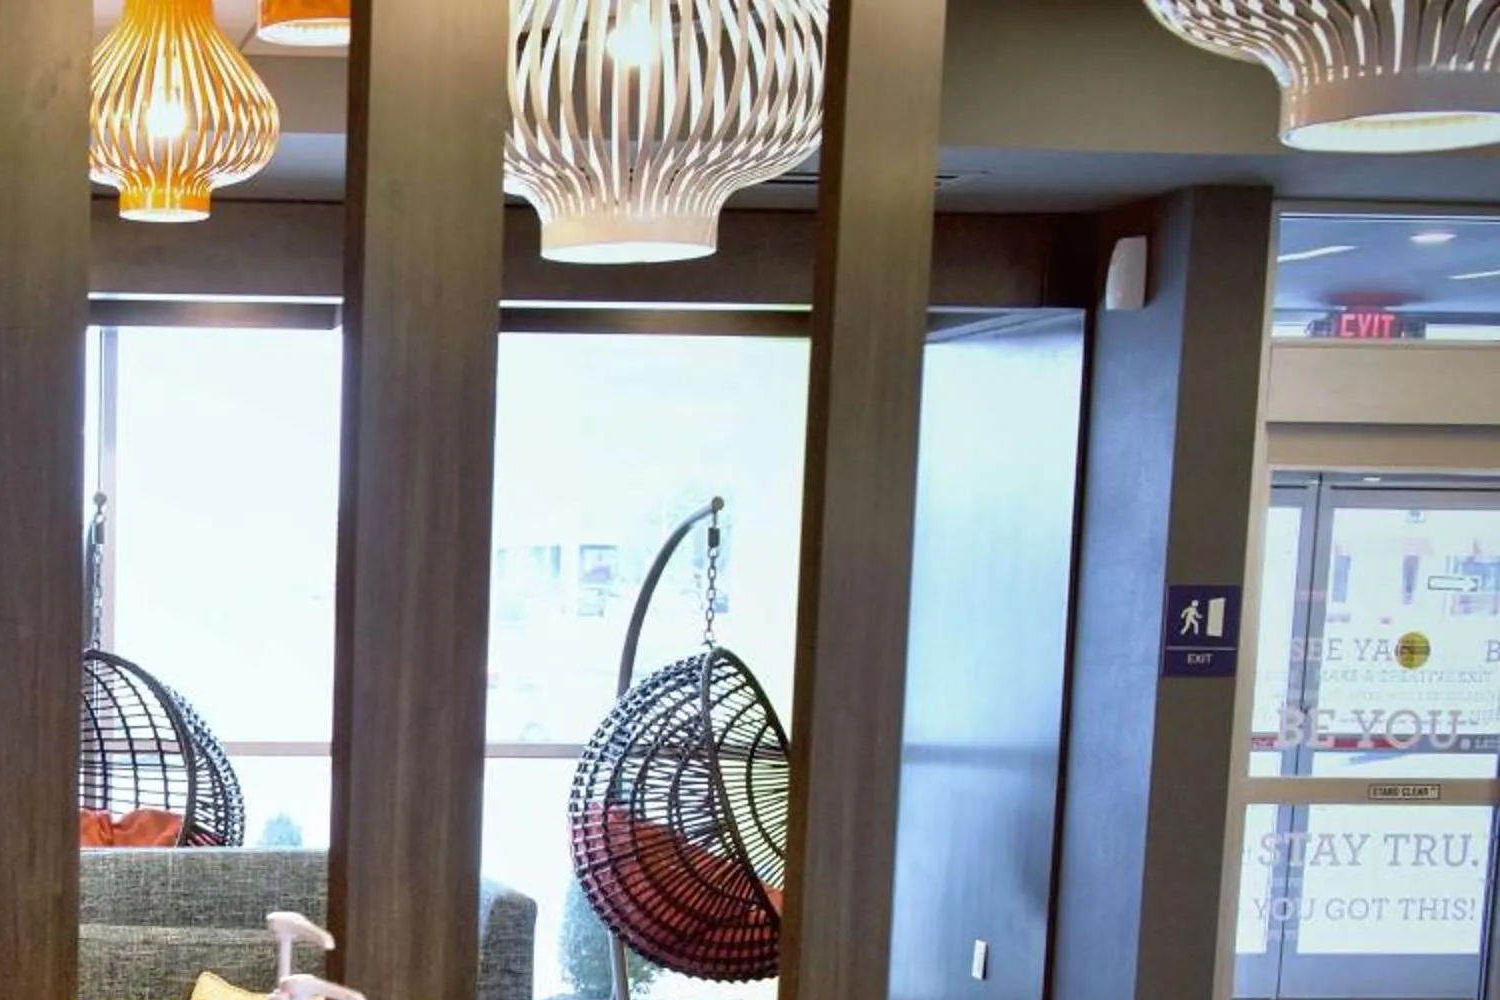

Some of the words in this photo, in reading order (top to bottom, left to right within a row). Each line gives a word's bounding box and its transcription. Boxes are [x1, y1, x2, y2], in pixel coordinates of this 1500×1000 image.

[1340, 313, 1395, 337] EXIT
[1187, 653, 1213, 665] EXIT
[1276, 709, 1336, 749] BE
[1351, 709, 1472, 750] YOU.
[1257, 832, 1370, 867] STAY
[1383, 834, 1480, 867] TRU.
[1252, 898, 1315, 921] YOU
[1324, 898, 1390, 921] GOT
[1397, 898, 1477, 921] THIS!
